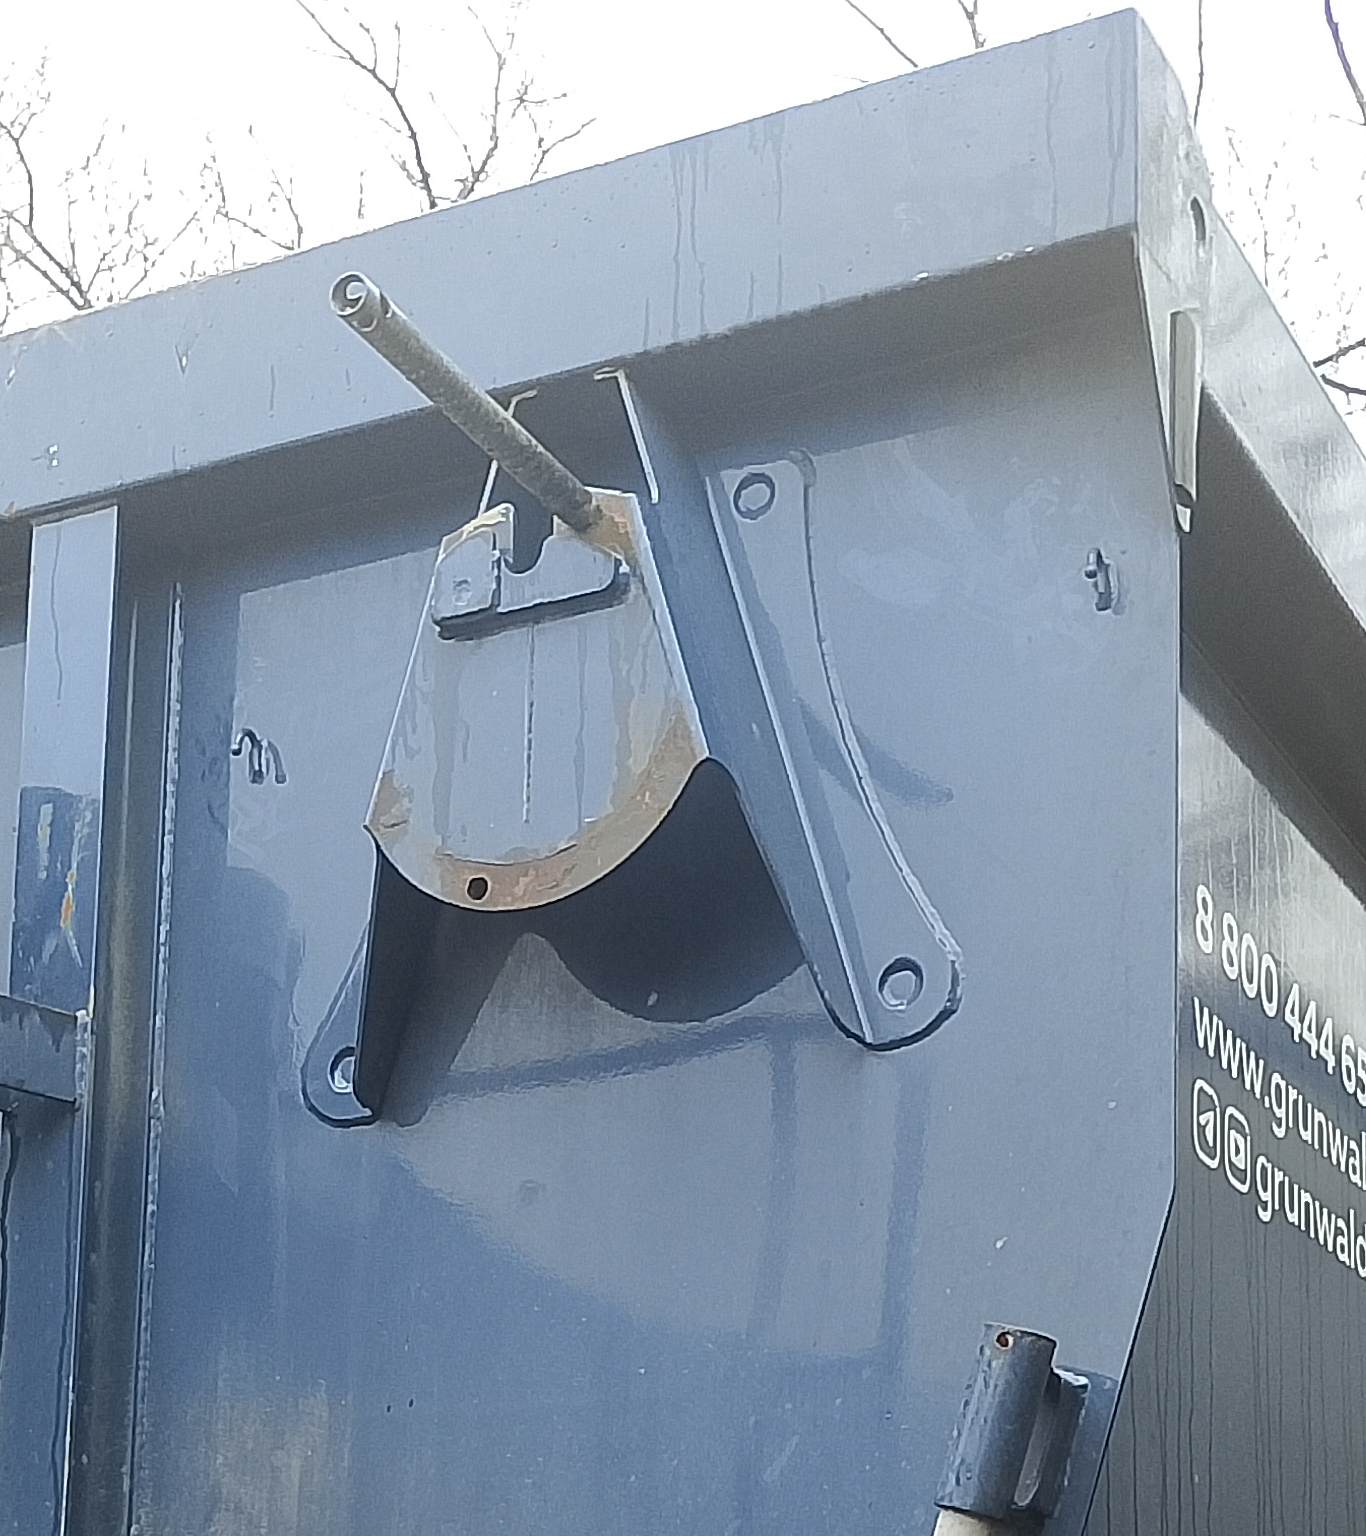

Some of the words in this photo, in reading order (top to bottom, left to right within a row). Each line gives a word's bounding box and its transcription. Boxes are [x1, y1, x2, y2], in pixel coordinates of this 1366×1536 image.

[1195, 885, 1214, 953] 8
[1221, 912, 1278, 1018] 800
[1285, 983, 1336, 1075] 444
